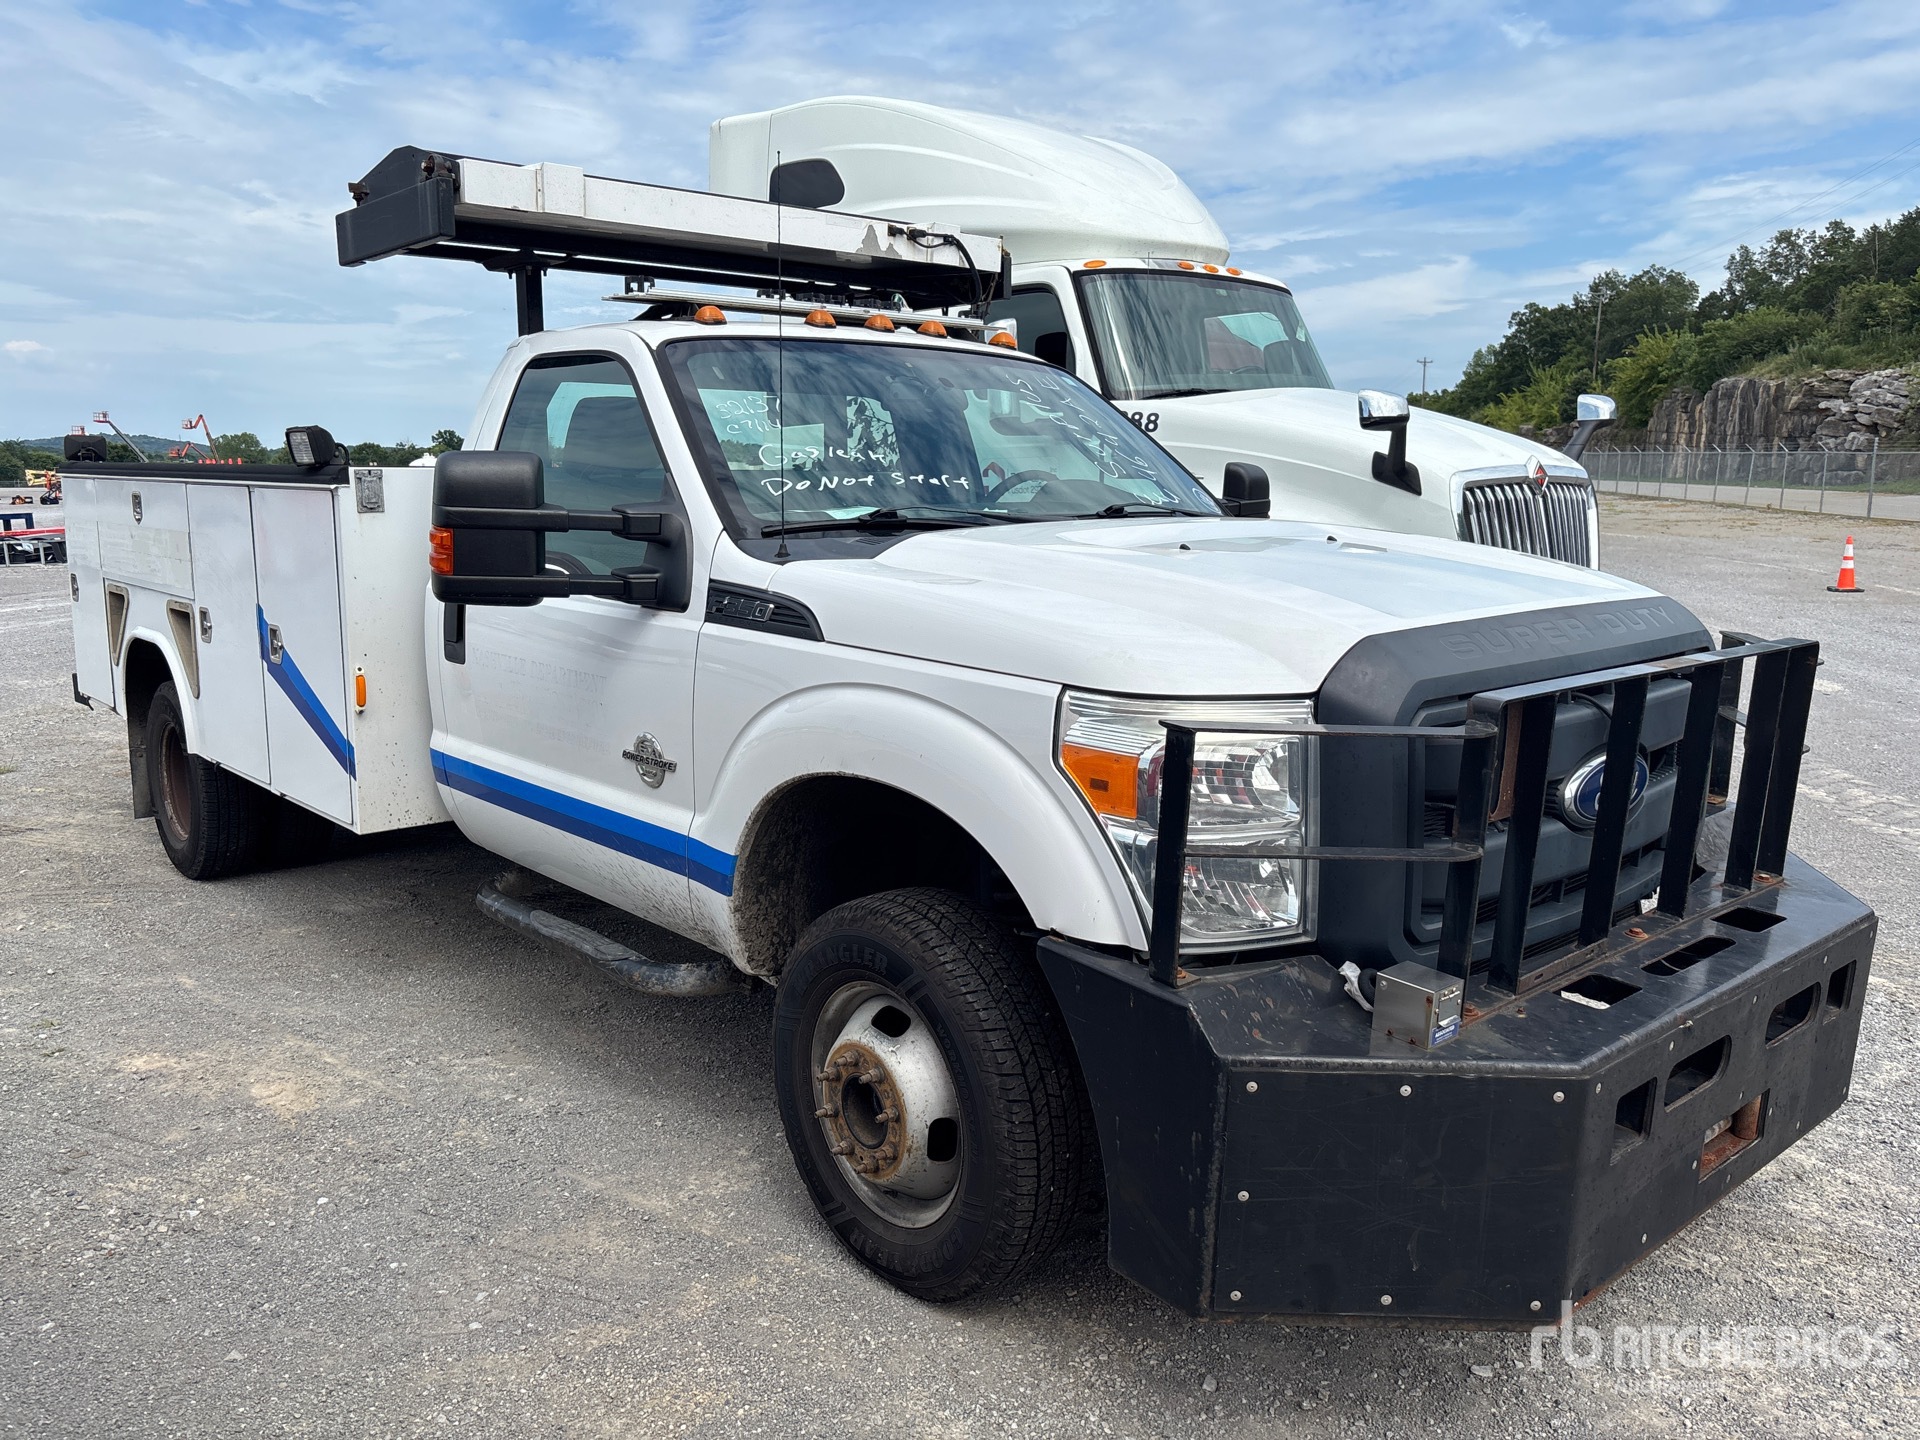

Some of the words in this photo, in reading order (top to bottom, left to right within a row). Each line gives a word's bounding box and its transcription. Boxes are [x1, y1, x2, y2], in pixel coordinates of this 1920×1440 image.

[1120, 410, 1160, 433] 88
[758, 444, 819, 467] Gas
[818, 474, 876, 491] Not
[890, 472, 970, 490] Start
[1439, 617, 1594, 660] SUPER
[1597, 605, 1675, 635] DUTY
[530, 659, 608, 694] DEPARTMENT
[791, 943, 889, 996] WRANGLER
